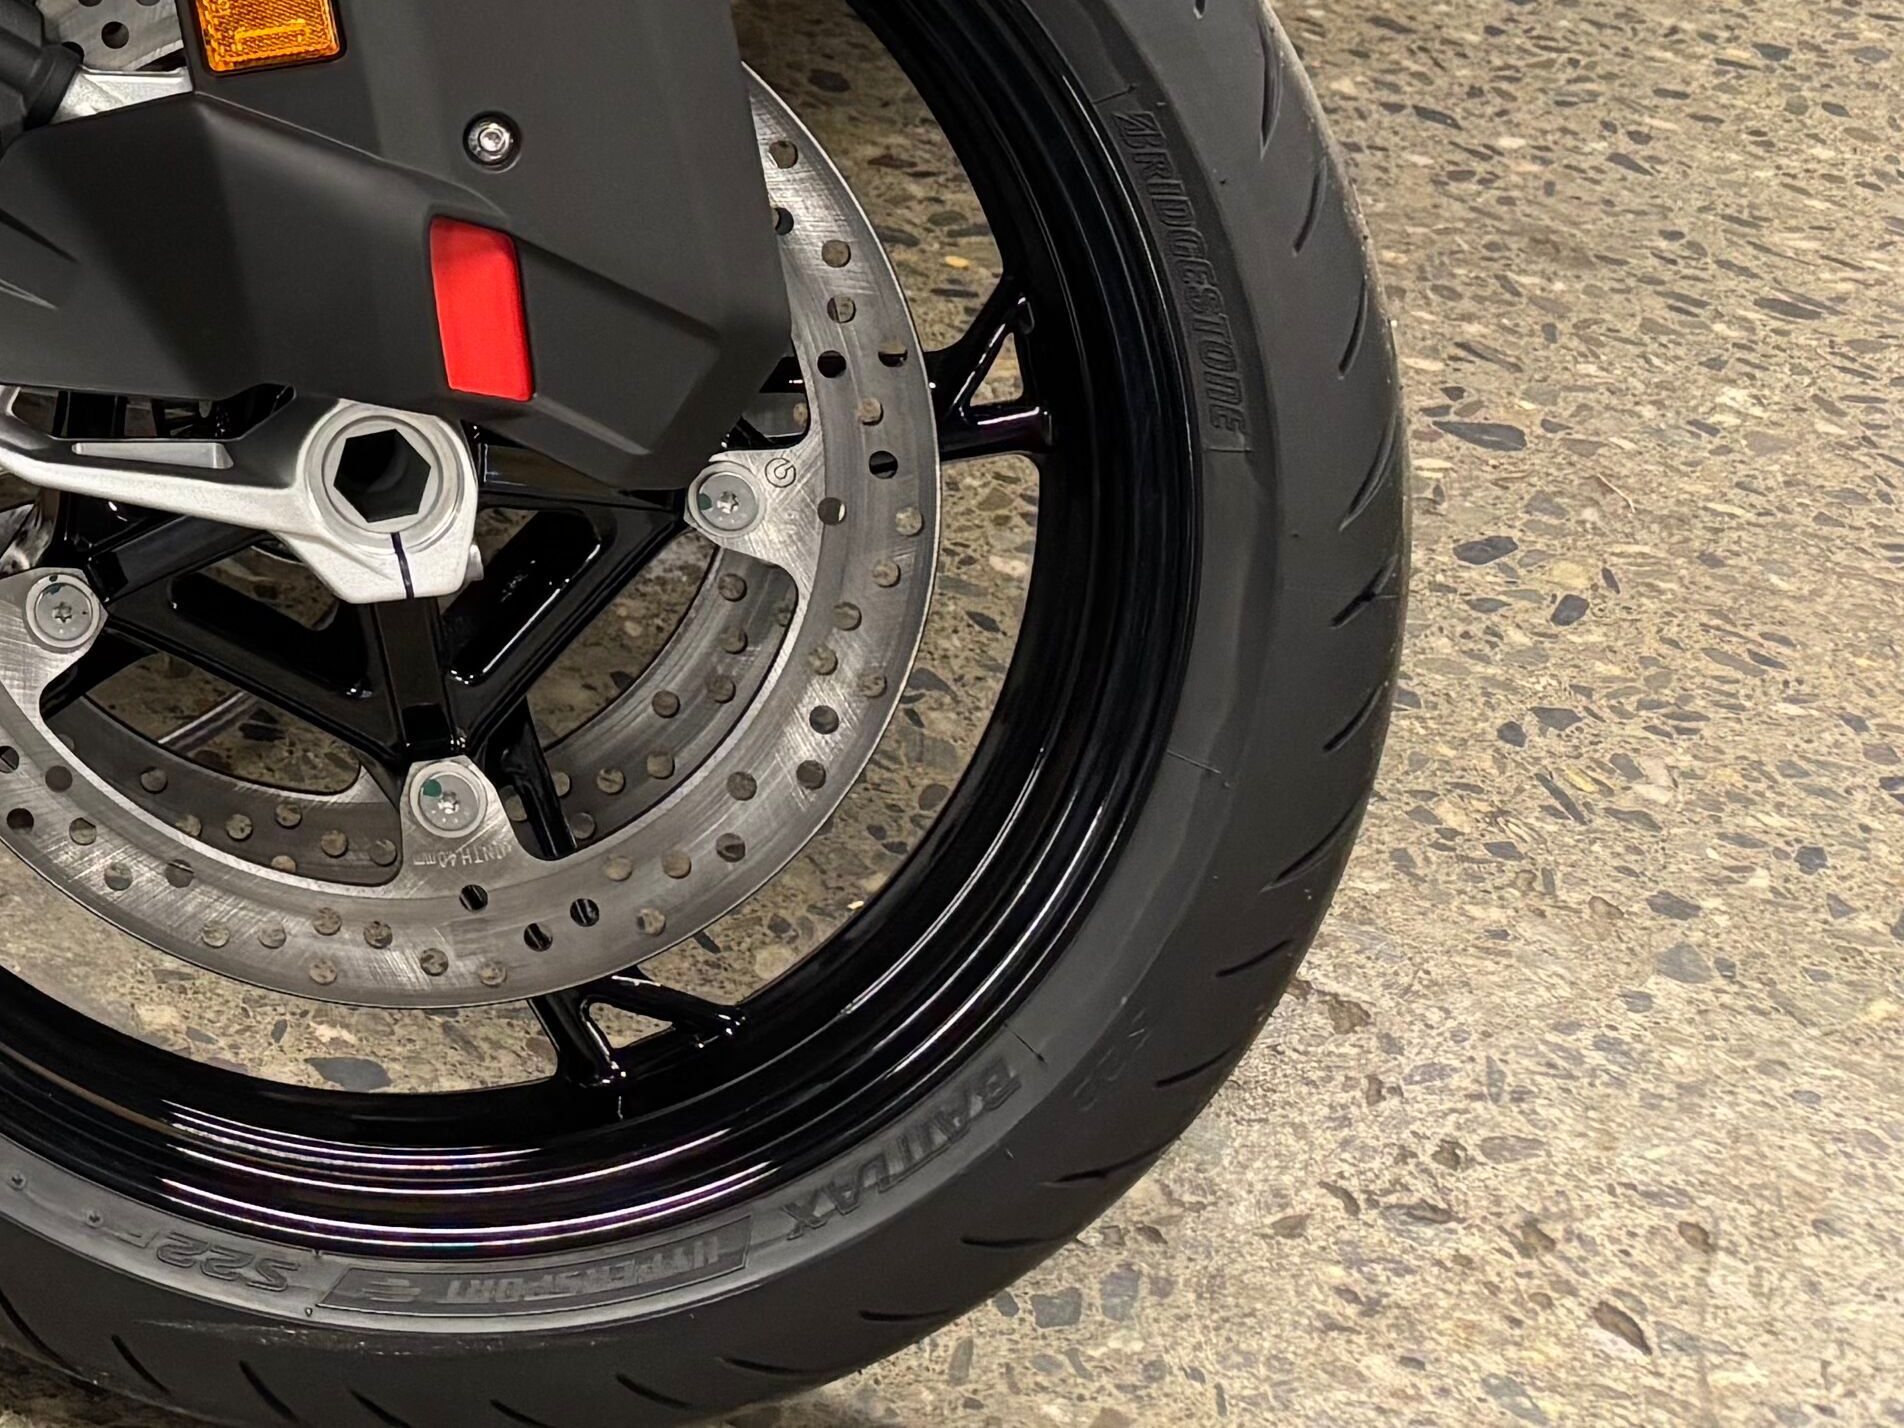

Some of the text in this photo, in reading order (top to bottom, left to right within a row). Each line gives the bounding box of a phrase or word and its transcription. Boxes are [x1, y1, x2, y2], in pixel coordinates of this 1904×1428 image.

[1110, 109, 1248, 437] BRIDGESTONE
[779, 1056, 1023, 1242] BATTLAX
[445, 1234, 721, 1305] HYPERSPORT
